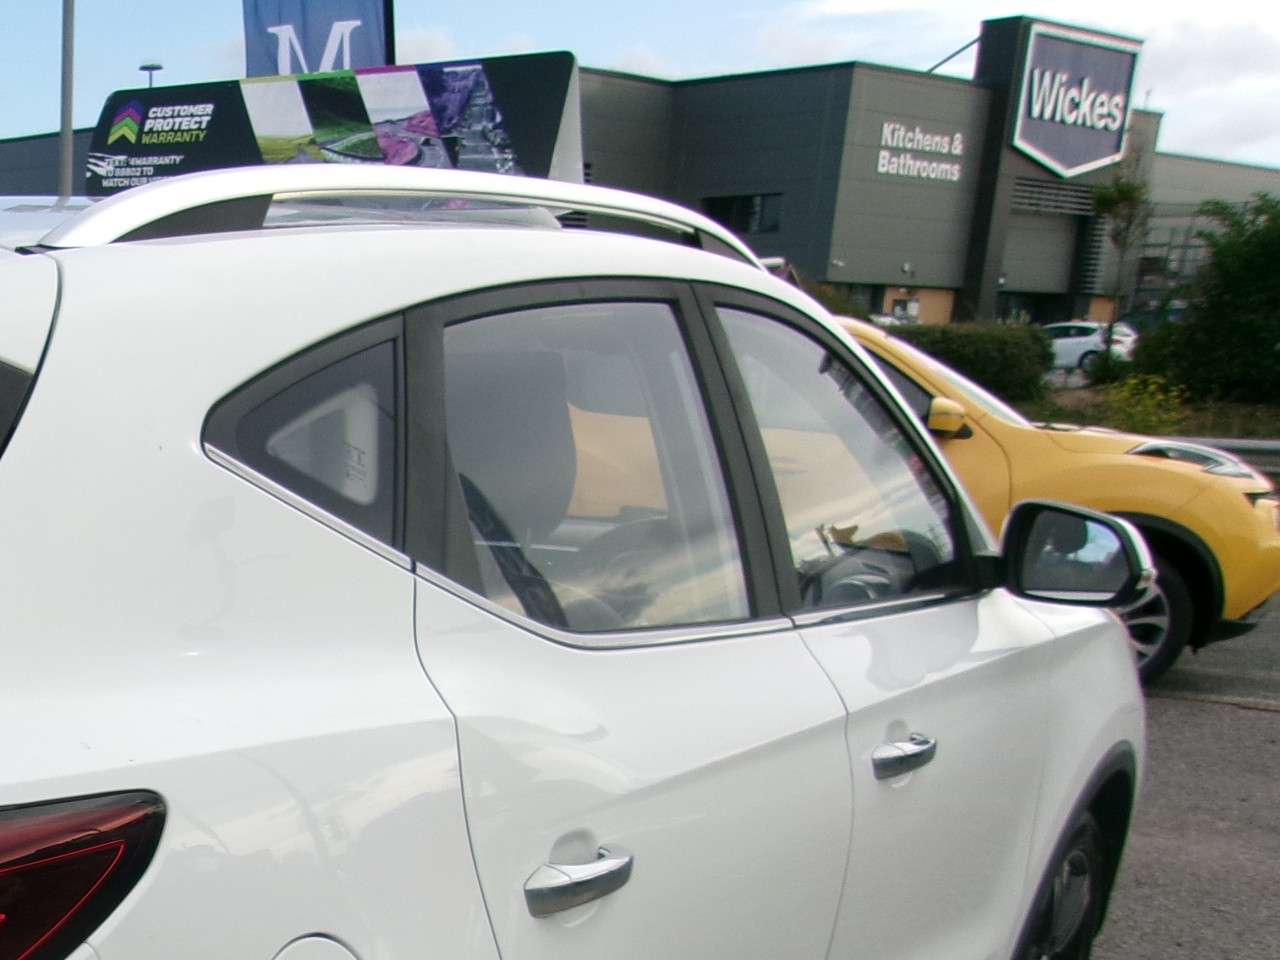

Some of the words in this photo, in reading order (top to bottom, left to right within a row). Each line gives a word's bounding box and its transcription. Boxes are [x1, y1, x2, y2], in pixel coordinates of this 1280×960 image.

[148, 103, 215, 118] CUSTOMER
[1028, 67, 1123, 132] Wickes
[144, 116, 212, 132] PROTECT
[141, 130, 207, 145] WARRANTY
[881, 121, 951, 154] Kitchens
[952, 133, 964, 156] &
[877, 150, 961, 182] Bathrooms
